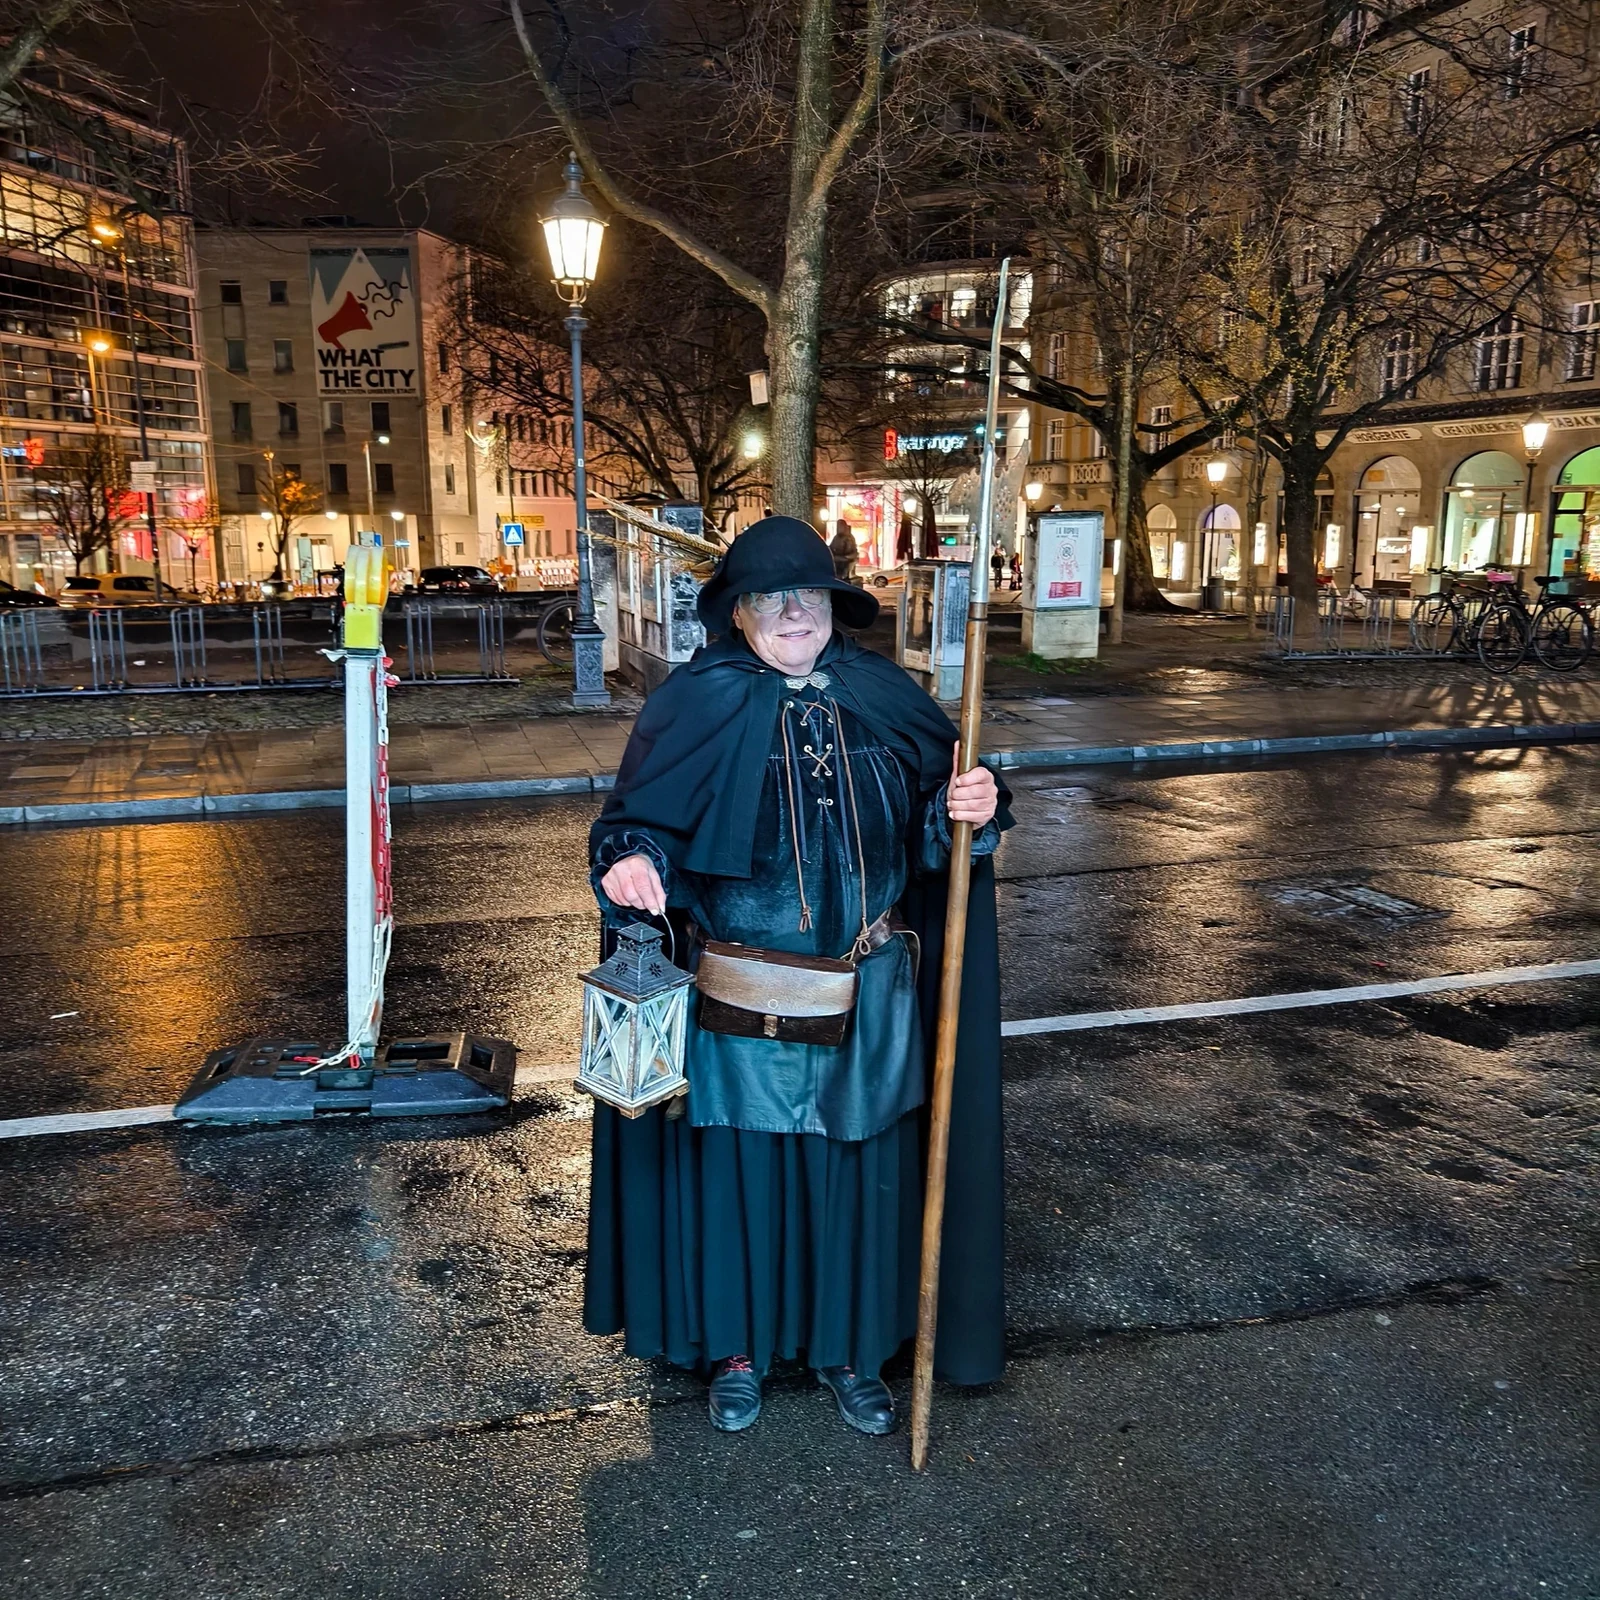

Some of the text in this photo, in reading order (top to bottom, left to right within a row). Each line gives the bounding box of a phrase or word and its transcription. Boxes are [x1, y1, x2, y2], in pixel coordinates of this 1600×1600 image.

[318, 349, 384, 367] WHAT
[319, 369, 415, 387] THE CITY
